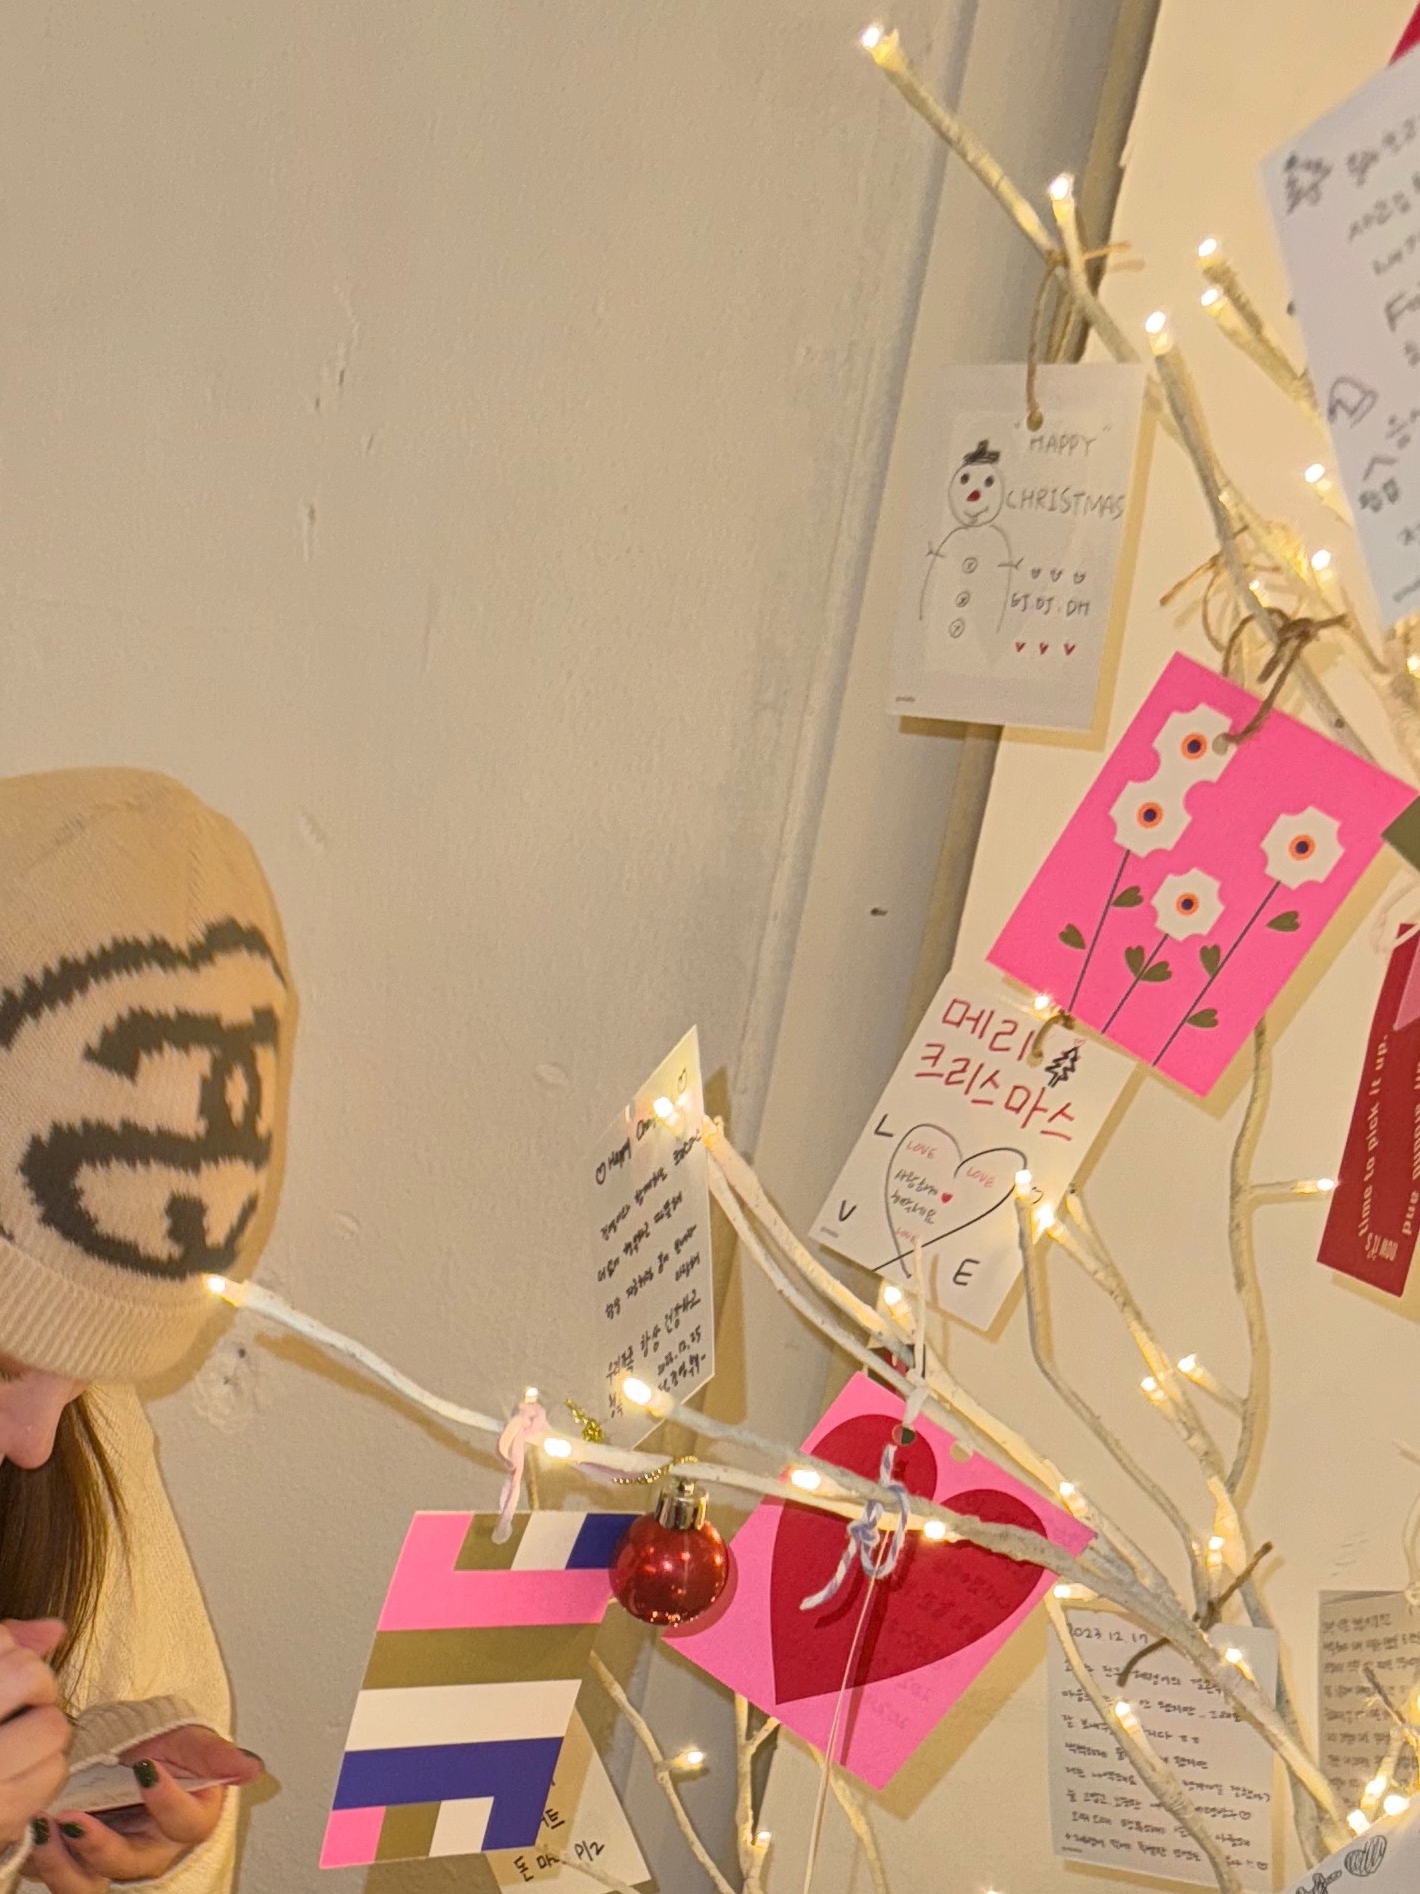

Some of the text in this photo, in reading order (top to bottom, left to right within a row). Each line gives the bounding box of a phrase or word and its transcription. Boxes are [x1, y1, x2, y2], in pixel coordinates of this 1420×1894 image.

[1005, 486, 1126, 522] CHRISTMAS
[941, 998, 1036, 1062] 메리
[914, 1042, 1076, 1143] 크리스마스
[1369, 1077, 1382, 1097] it
[1367, 1102, 1380, 1152] pick
[1363, 1160, 1375, 1183] to
[1358, 1185, 1374, 1236] time
[952, 1258, 981, 1286] E
[640, 1323, 661, 1358] 항상
[664, 1289, 701, 1335] 건강하고
[513, 1855, 535, 1882] 돈
